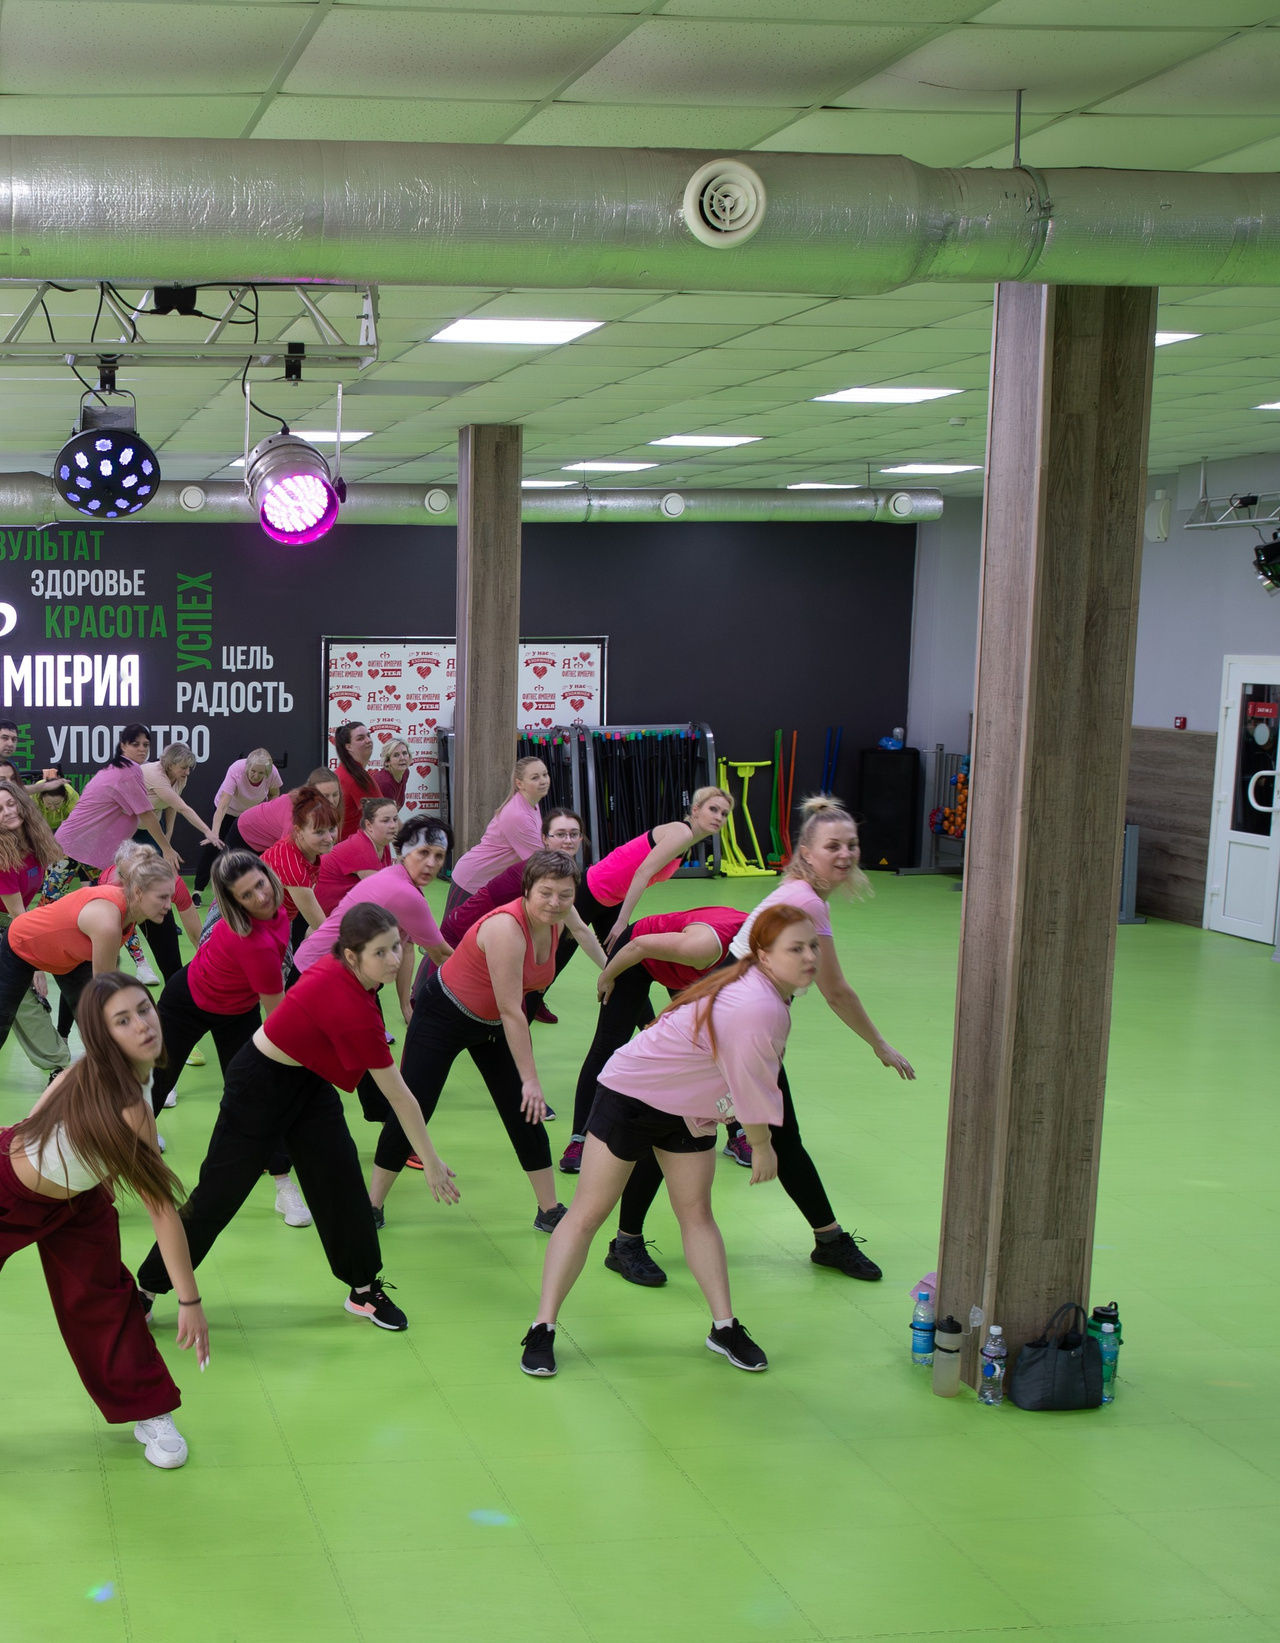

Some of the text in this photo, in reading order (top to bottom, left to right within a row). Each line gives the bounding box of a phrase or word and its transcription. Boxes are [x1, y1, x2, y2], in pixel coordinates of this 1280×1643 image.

[30, 569, 146, 600] ЗДОРОВЬЕ
[45, 604, 168, 639] КРАСОТА
[176, 571, 213, 672] УСПЕХ
[222, 645, 274, 673] ЦЕЛЬ
[176, 681, 294, 717] РАДОСТЬ
